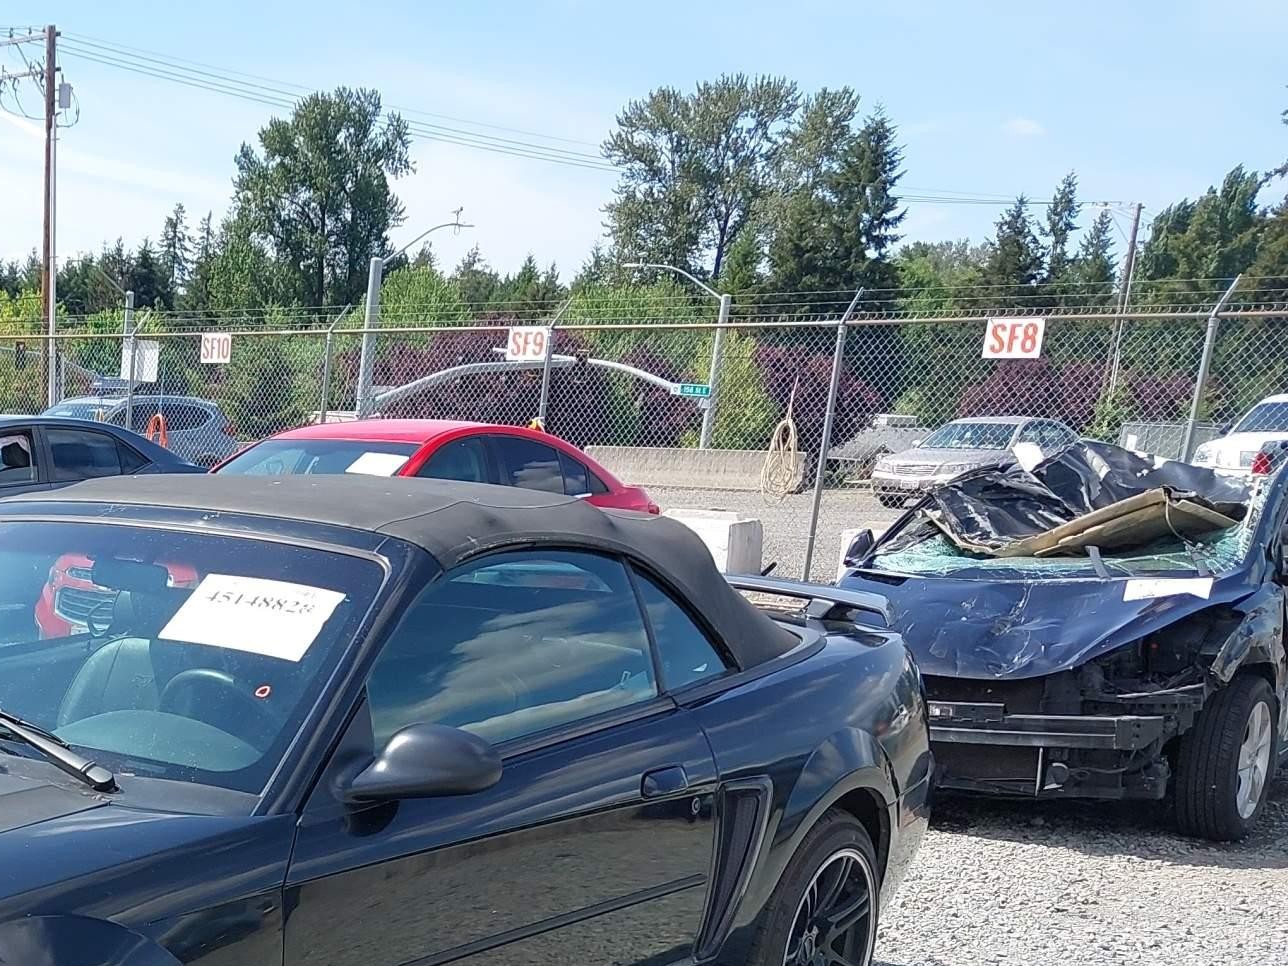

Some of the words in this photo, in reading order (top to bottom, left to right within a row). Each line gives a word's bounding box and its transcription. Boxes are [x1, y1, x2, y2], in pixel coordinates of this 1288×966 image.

[202, 337, 230, 359] SF10
[511, 331, 545, 356] SF9
[989, 322, 1039, 354] SF8
